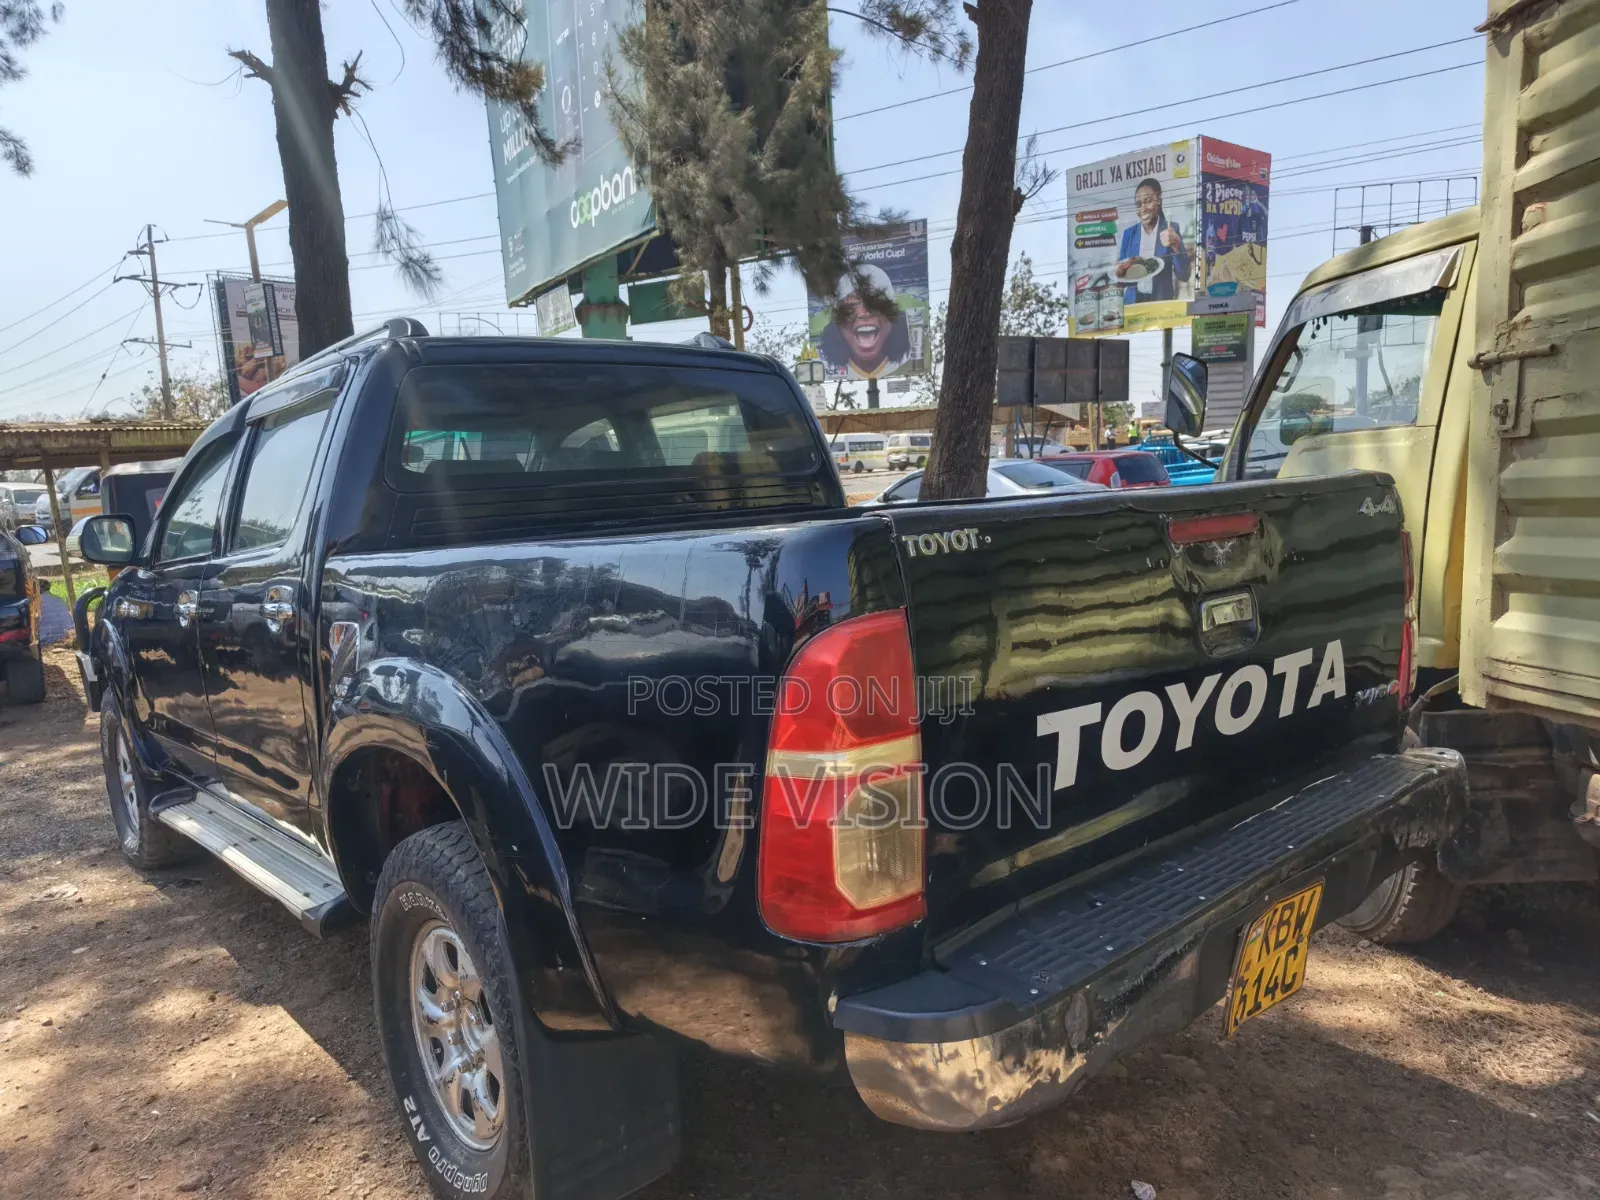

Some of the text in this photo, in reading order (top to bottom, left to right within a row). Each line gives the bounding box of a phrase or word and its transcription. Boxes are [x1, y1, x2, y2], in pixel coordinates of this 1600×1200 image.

[589, 2, 595, 17] 5
[592, 32, 597, 46] 8
[603, 20, 608, 35] 9
[1075, 154, 1167, 191] ORIJI. YA KISIAGI
[1205, 182, 1213, 203] 2
[1085, 238, 1115, 246] NUTRITIOUS
[1241, 231, 1257, 242] PEPSI
[1036, 639, 1347, 792] TOYOTA
[1257, 890, 1317, 963] KBW
